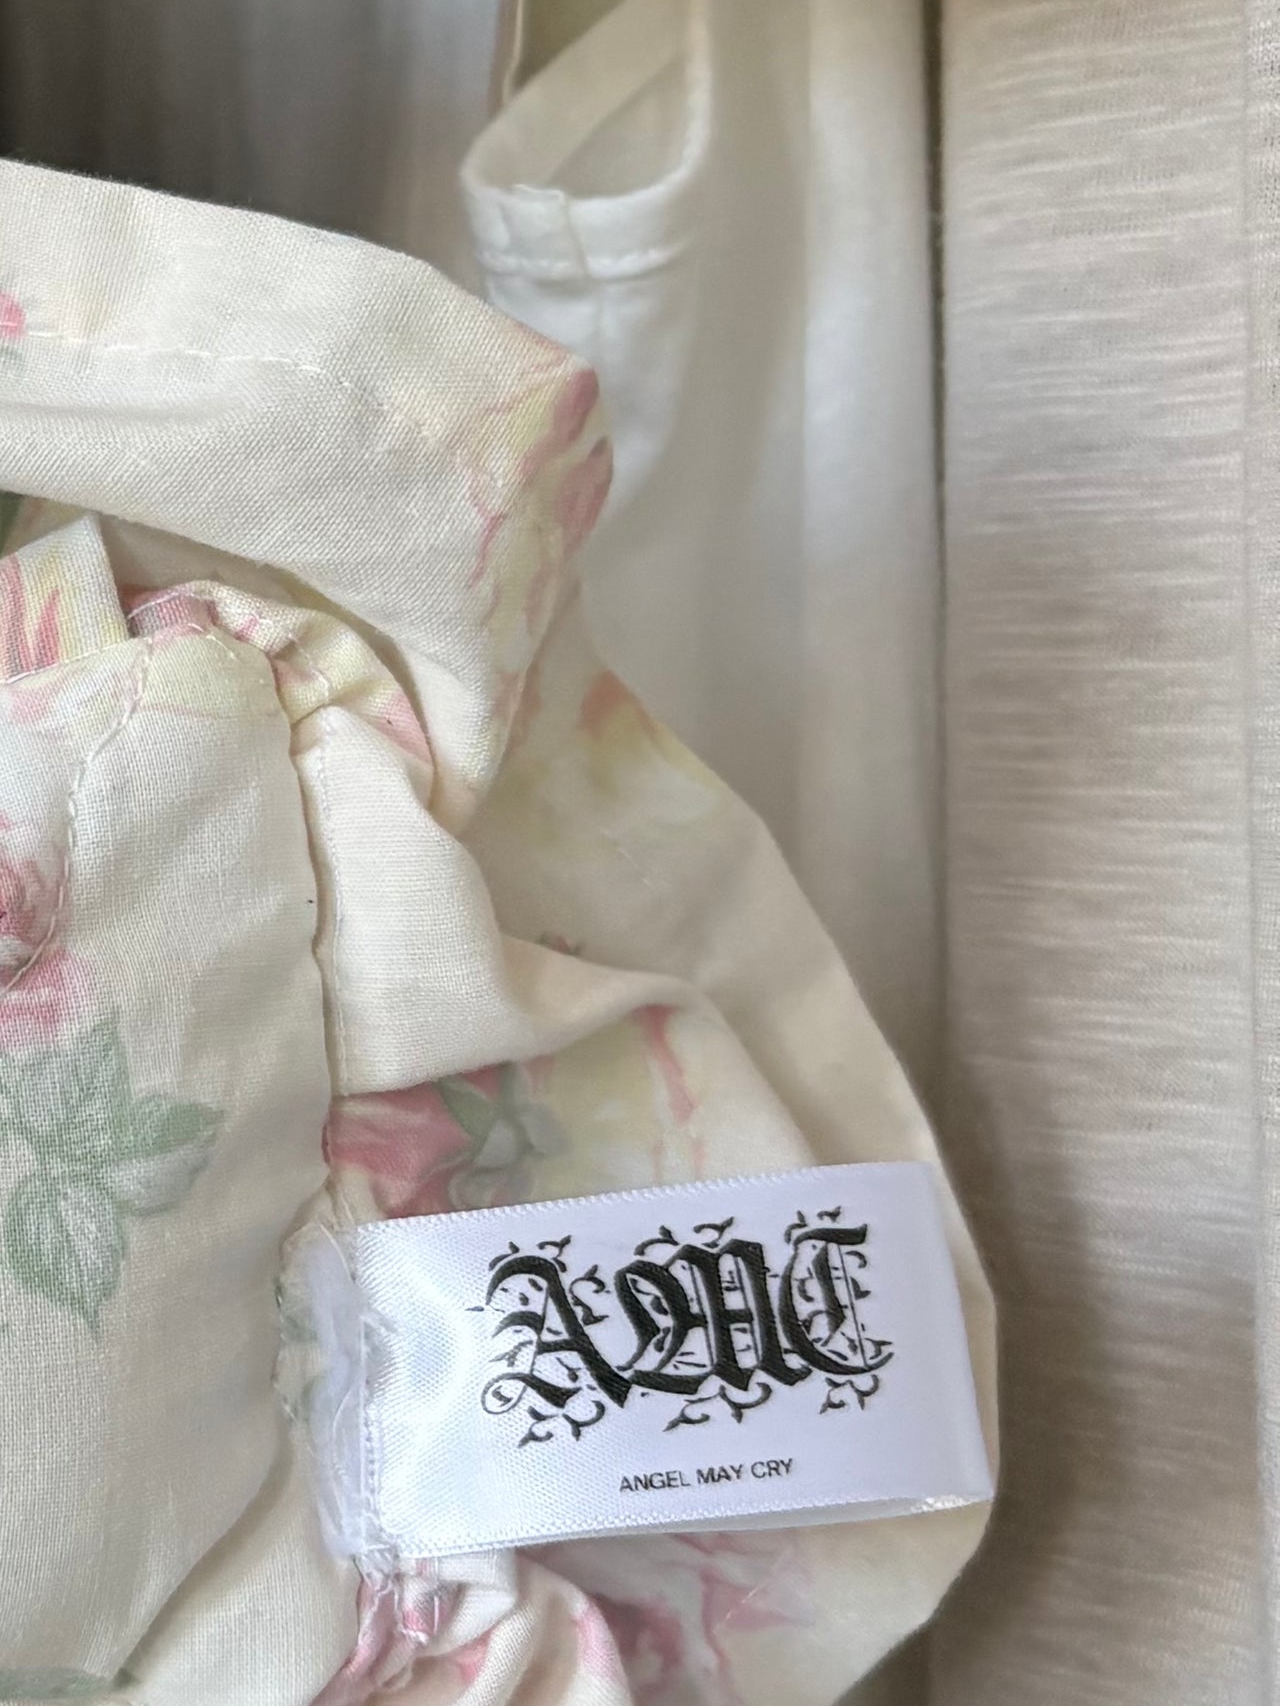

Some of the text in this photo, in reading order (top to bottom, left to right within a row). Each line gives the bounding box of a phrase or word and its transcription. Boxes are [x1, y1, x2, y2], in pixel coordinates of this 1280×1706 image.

[619, 1458, 793, 1493] ANGEL MAY CRY
